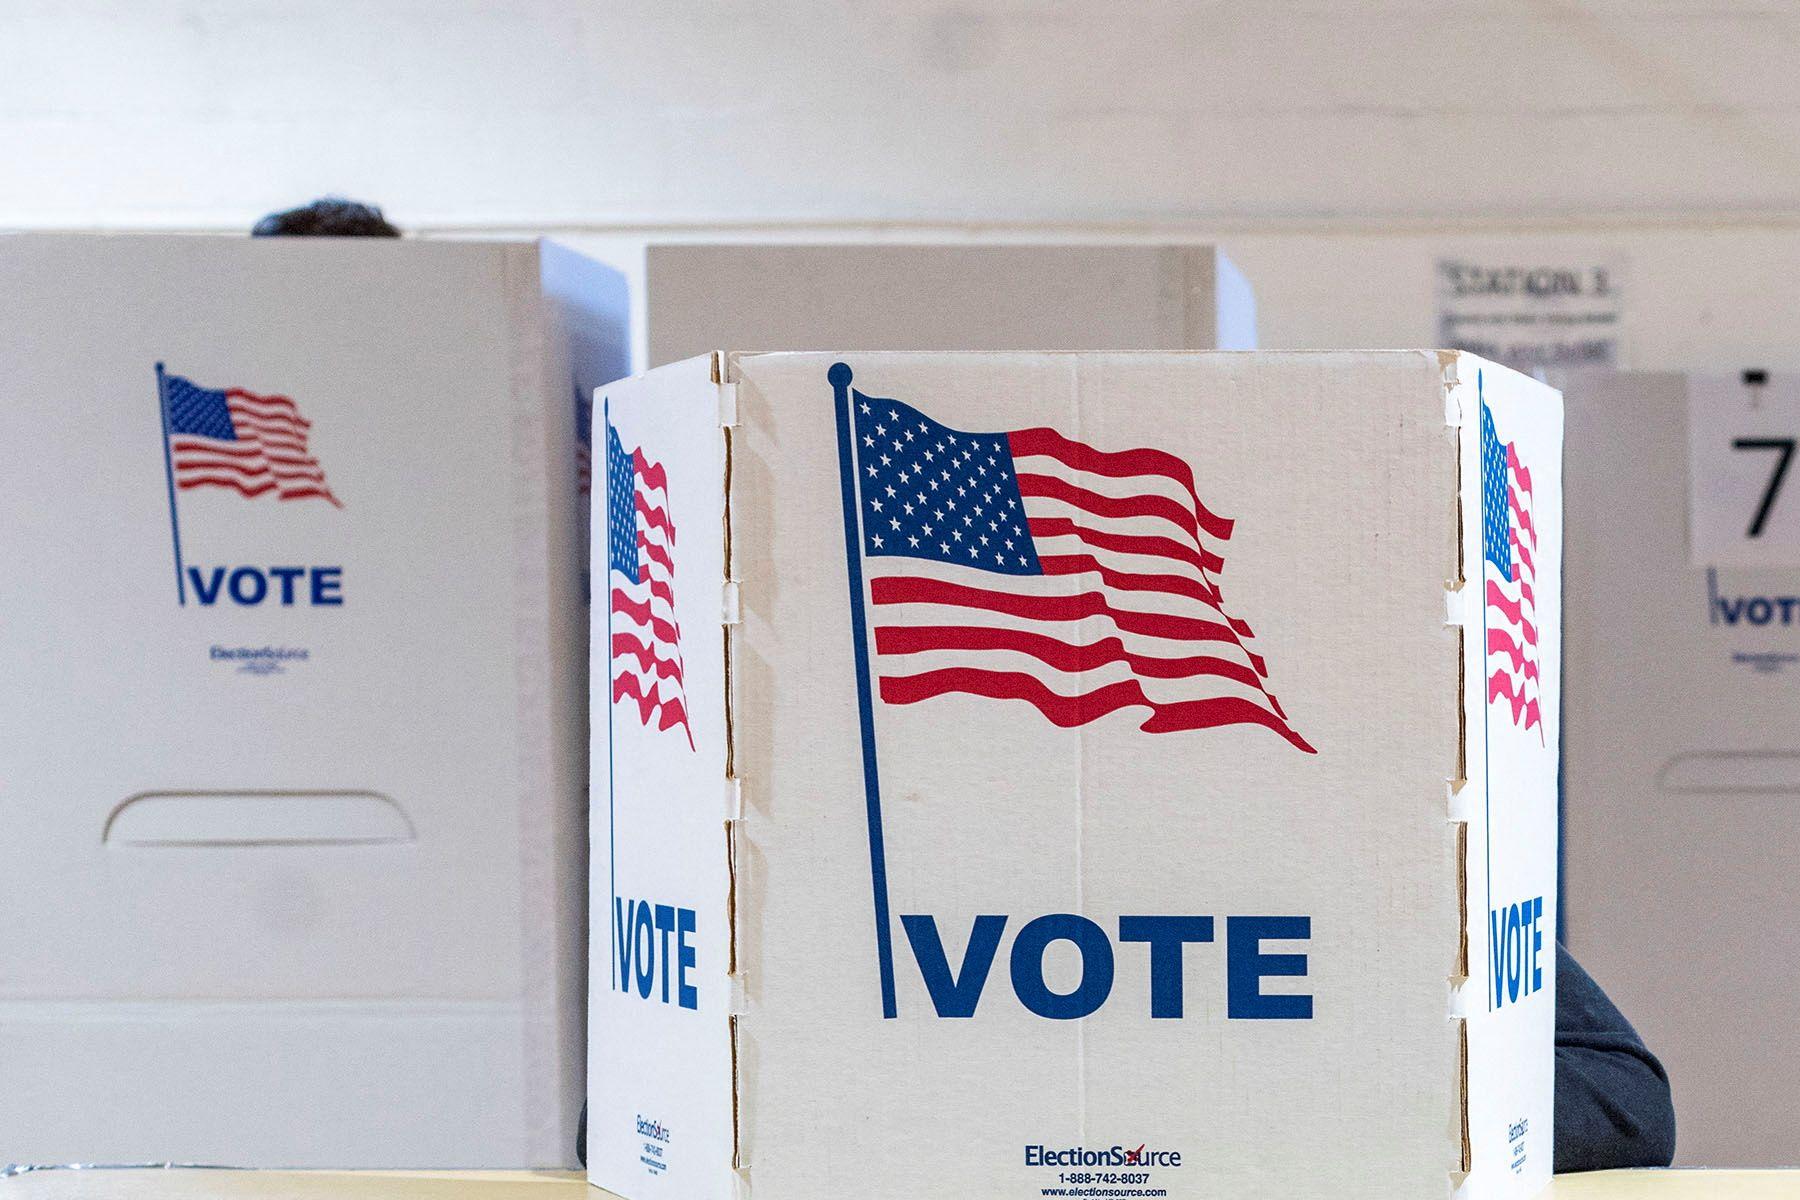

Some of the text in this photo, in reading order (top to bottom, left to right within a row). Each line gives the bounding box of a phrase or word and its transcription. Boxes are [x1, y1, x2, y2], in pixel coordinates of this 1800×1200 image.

[1731, 438, 1798, 538] 7
[187, 567, 344, 606] VOTE
[616, 896, 697, 1010] VOTE
[900, 913, 1313, 1020] VOTE
[1492, 896, 1542, 1008] VOTE
[1025, 1144, 1181, 1167] ElectionSource
[1059, 1173, 1150, 1184] 1-888-742-8037
[1041, 1187, 1167, 1197] www.electionsource.com
